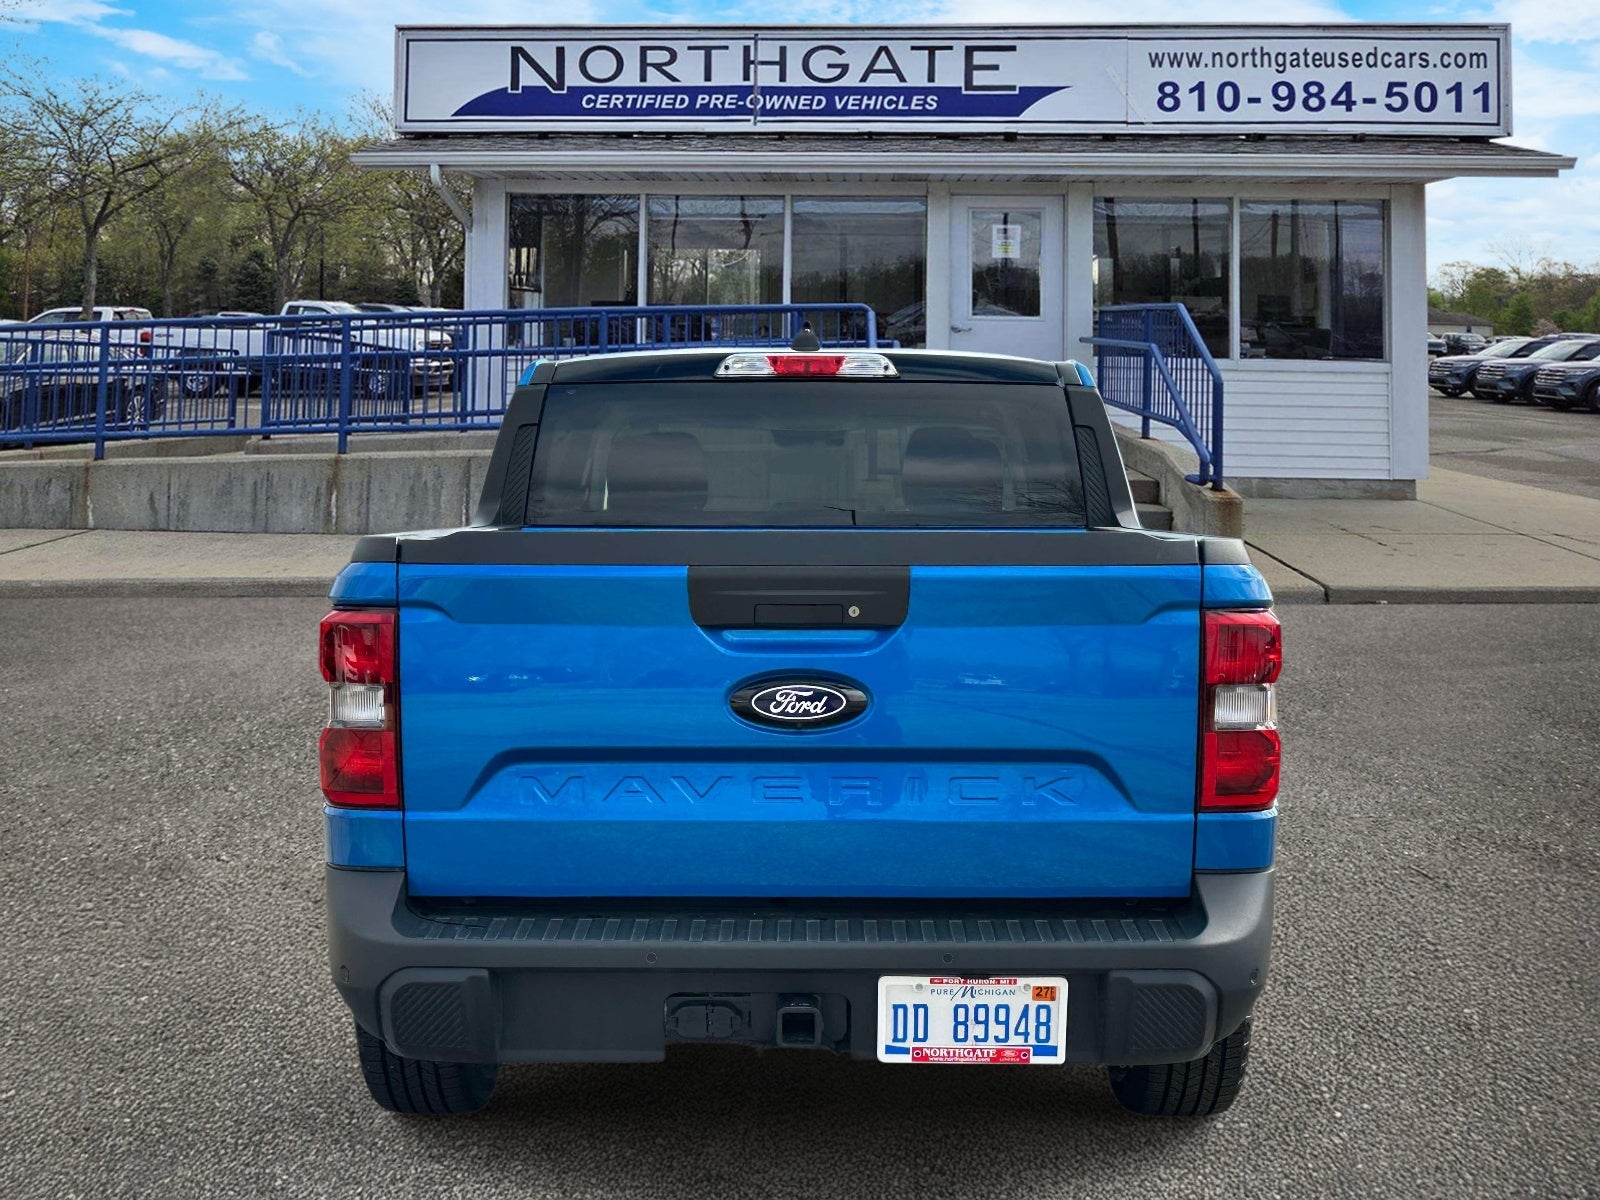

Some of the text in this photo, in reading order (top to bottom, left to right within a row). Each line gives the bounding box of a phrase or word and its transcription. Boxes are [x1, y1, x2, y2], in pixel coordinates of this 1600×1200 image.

[509, 44, 1017, 92] NORTHGATE
[1148, 46, 1488, 74] www.northgateusedcars.com
[580, 93, 939, 111] CERTIFIED PRE-OWNED VEHICLES
[1156, 80, 1491, 113] 810-984-5011
[769, 689, 828, 714] Ford
[518, 776, 1081, 806] MAVERICK
[930, 985, 1016, 1001] PURE MICHIGAN
[1035, 986, 1050, 998] 27
[892, 1003, 1051, 1044] DD 89948
[922, 1048, 997, 1058] NORTHGATE
